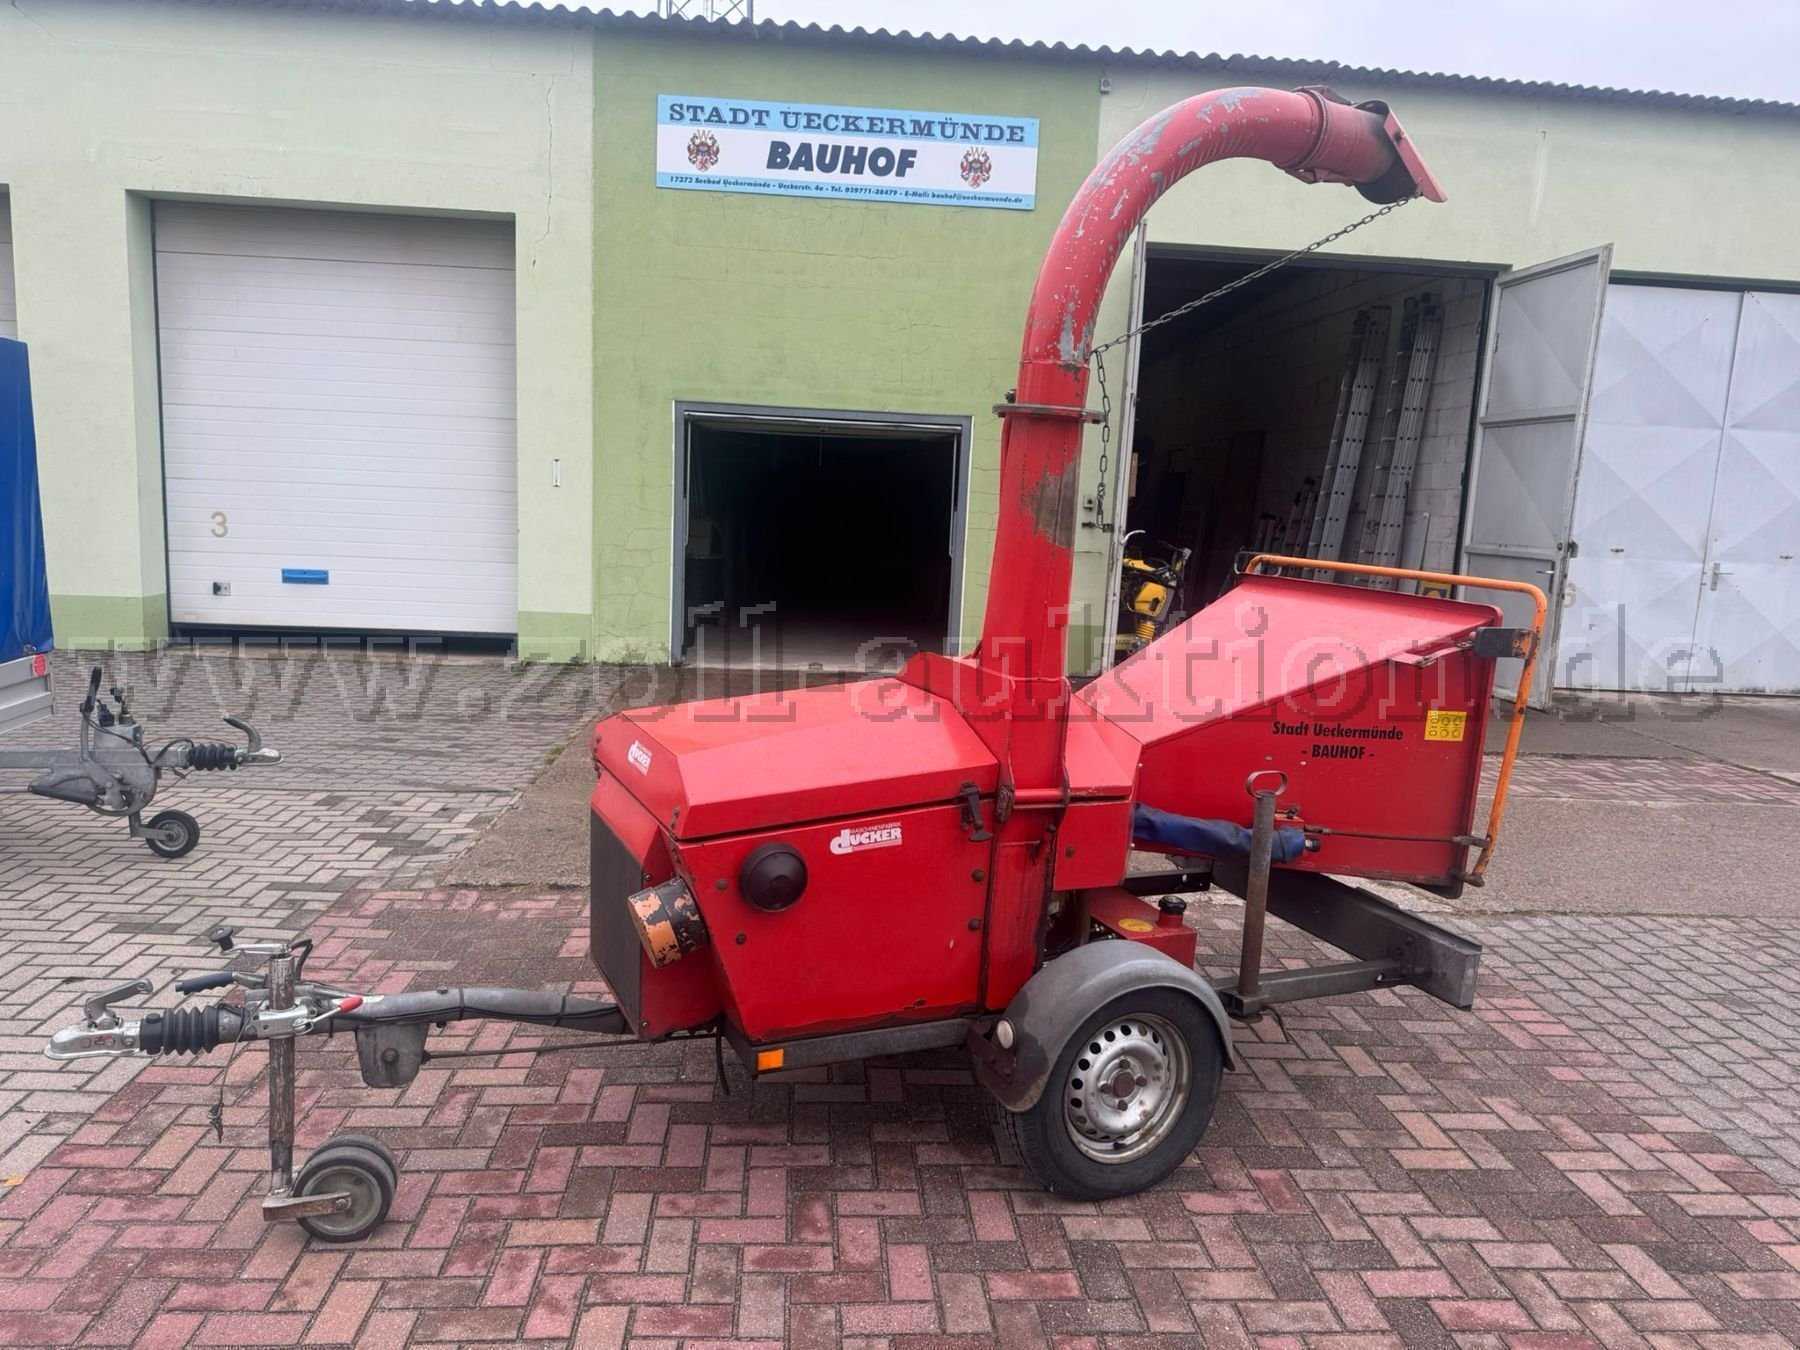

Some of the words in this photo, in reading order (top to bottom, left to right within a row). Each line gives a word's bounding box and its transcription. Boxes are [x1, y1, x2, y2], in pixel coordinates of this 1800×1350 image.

[669, 103, 770, 127] STADT
[779, 111, 1025, 143] UECKERMÜNDE
[766, 140, 918, 178] BAUHOF
[831, 185, 843, 193] Tel.
[211, 511, 229, 538] 3
[1272, 720, 1309, 736] Stadt
[1313, 722, 1404, 741] Ueckermünde
[1311, 744, 1366, 760] BAUHOF
